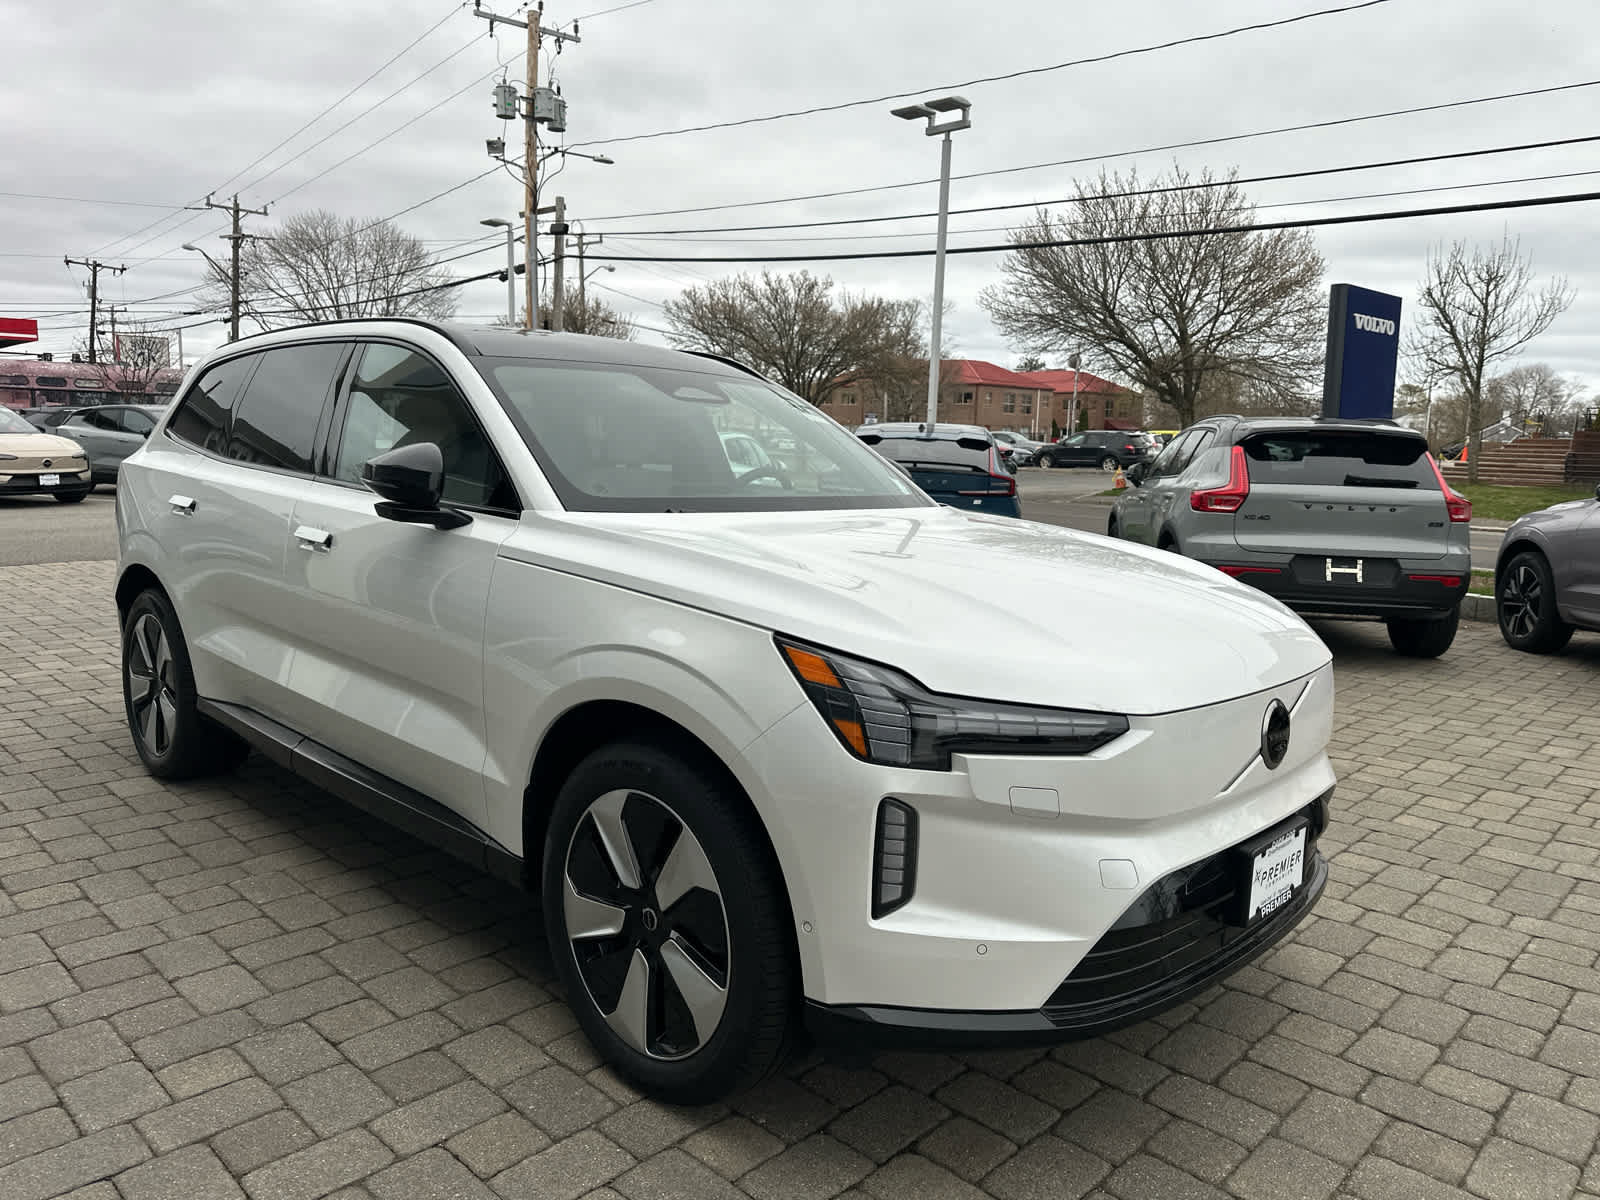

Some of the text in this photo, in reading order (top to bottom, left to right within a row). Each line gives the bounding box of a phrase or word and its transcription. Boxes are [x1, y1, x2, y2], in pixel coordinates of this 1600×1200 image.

[1353, 313, 1395, 336] VOLVO
[1303, 503, 1397, 513] VOLVO
[1260, 849, 1302, 886] PREMIER
[1260, 890, 1292, 919] PREMIER
